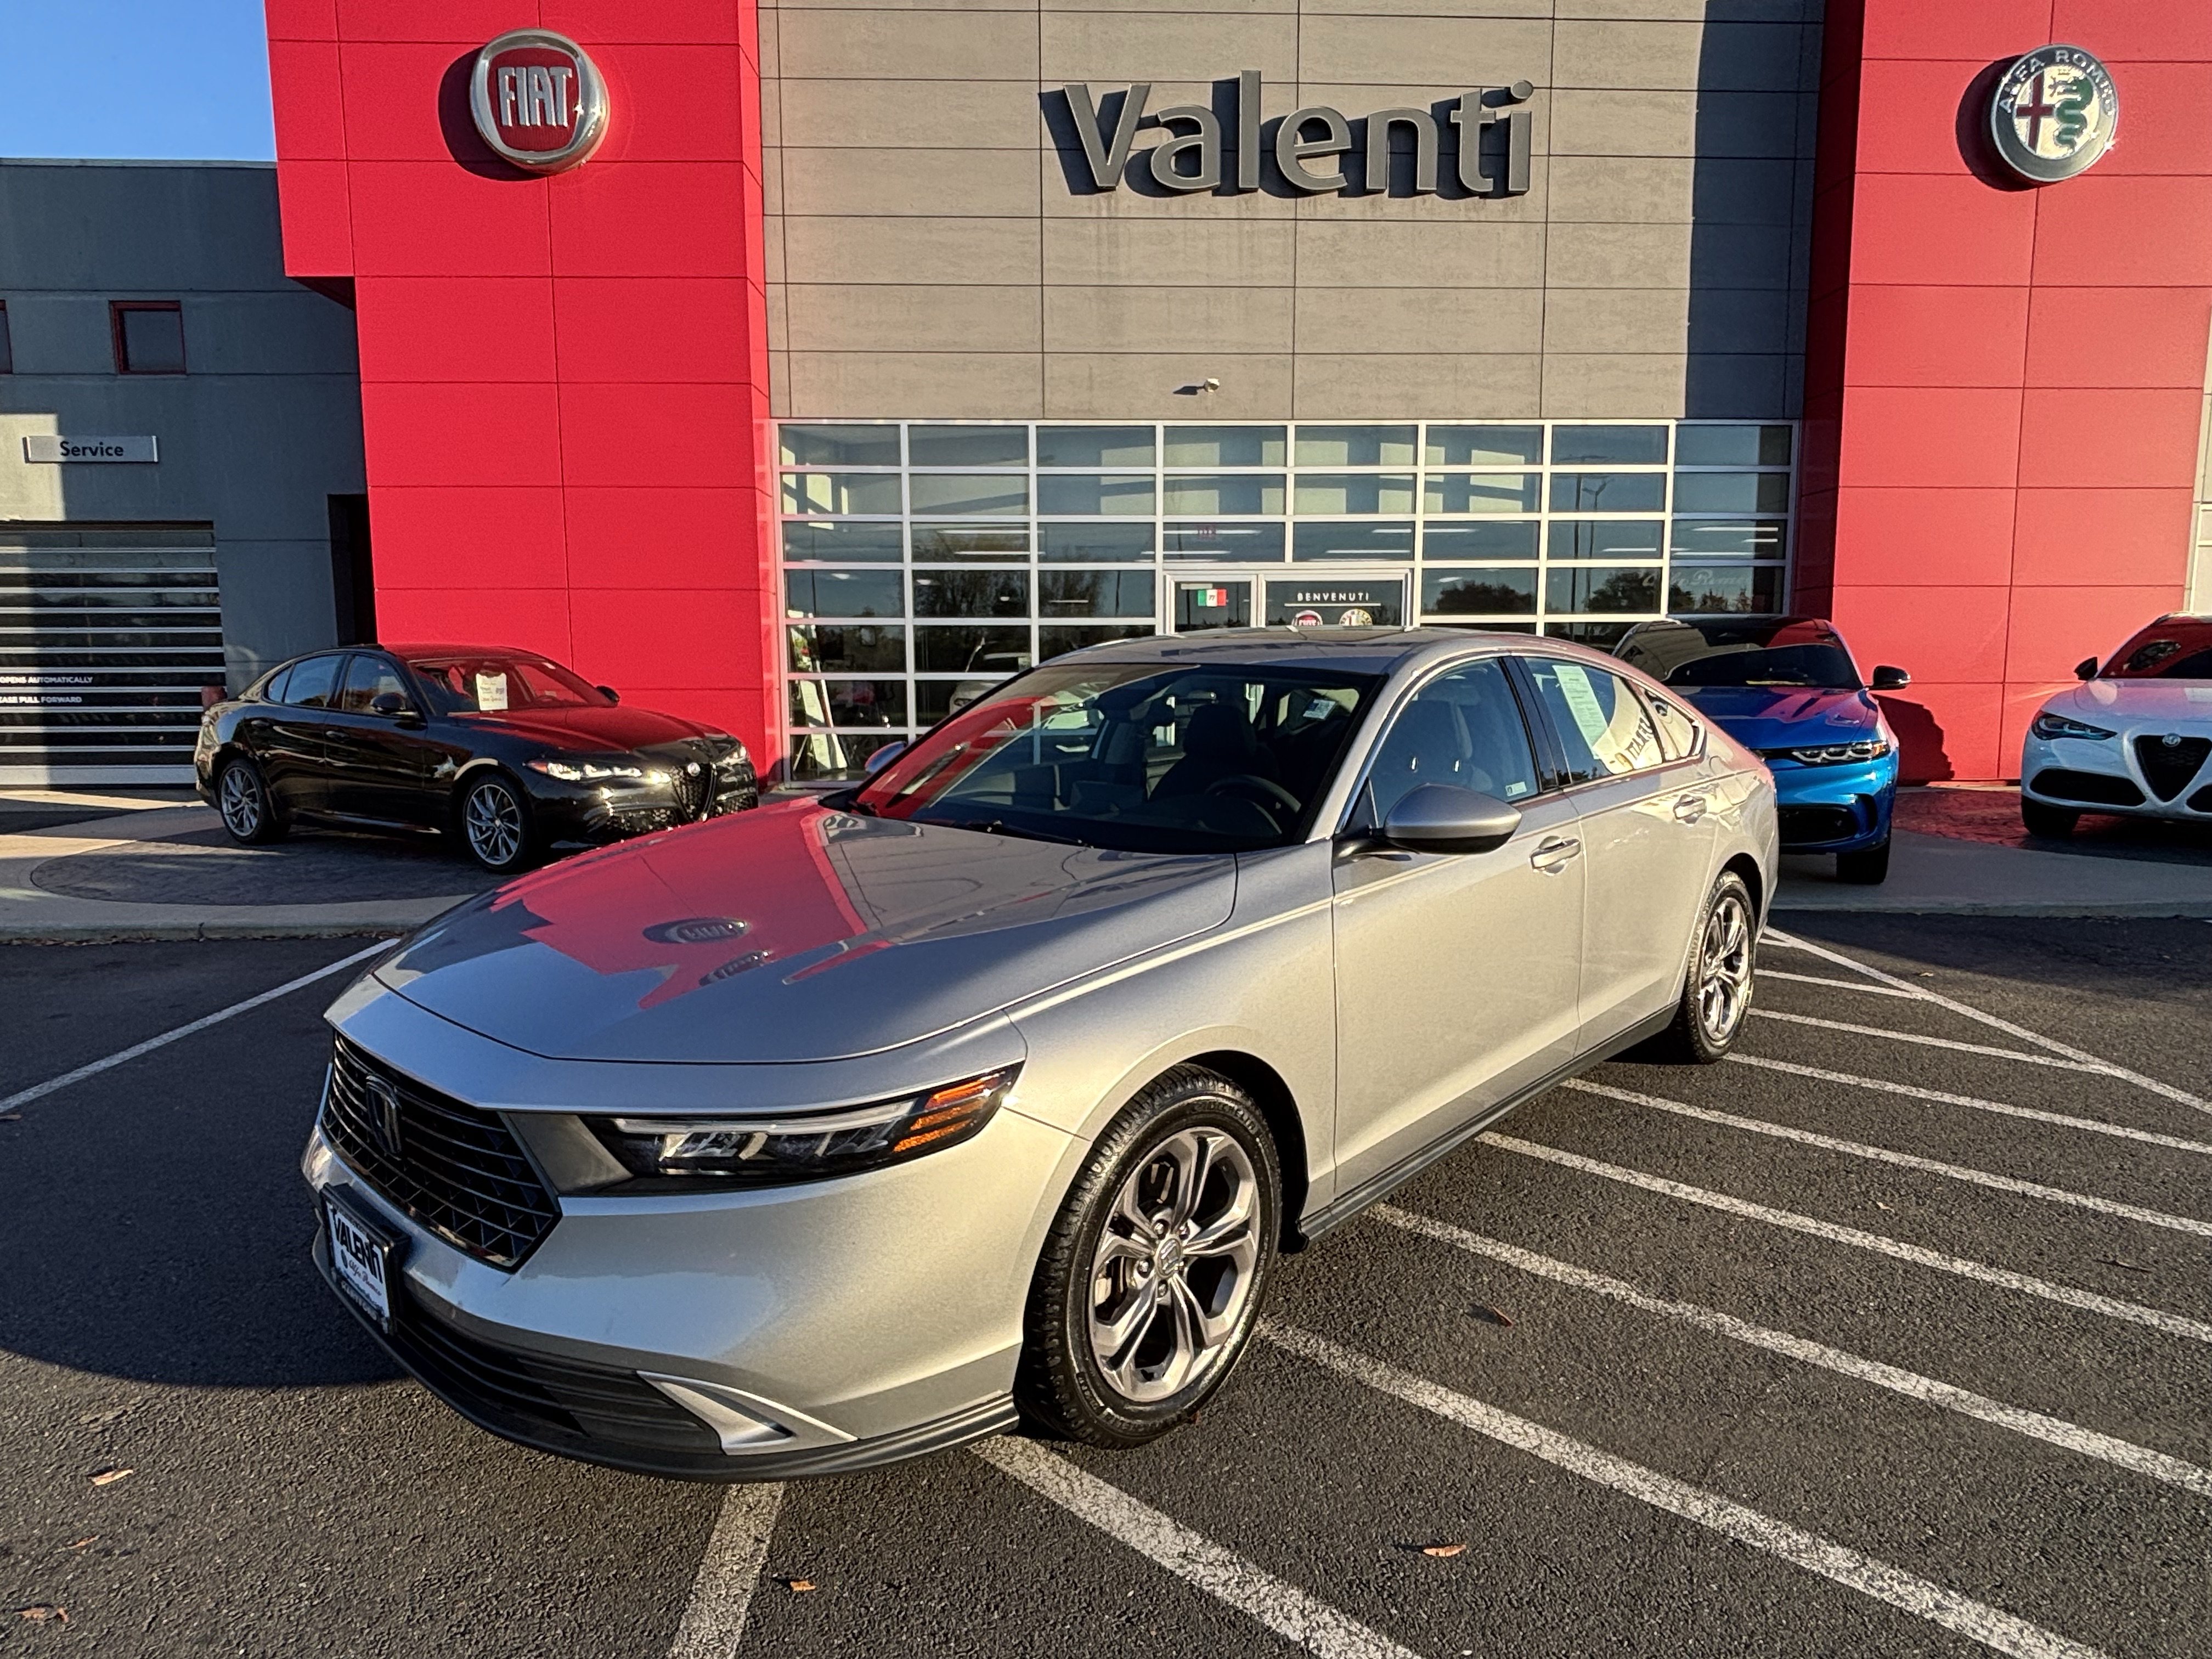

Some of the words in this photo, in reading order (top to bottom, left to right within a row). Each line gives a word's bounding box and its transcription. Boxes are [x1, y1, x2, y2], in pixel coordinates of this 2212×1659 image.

[498, 66, 572, 127] FIAT
[2000, 57, 2045, 114] ALFA
[2055, 49, 2115, 116] ROMEO
[1063, 70, 1533, 193] Valenti
[60, 441, 124, 456] Service
[1297, 592, 1369, 602] BENVENUTI
